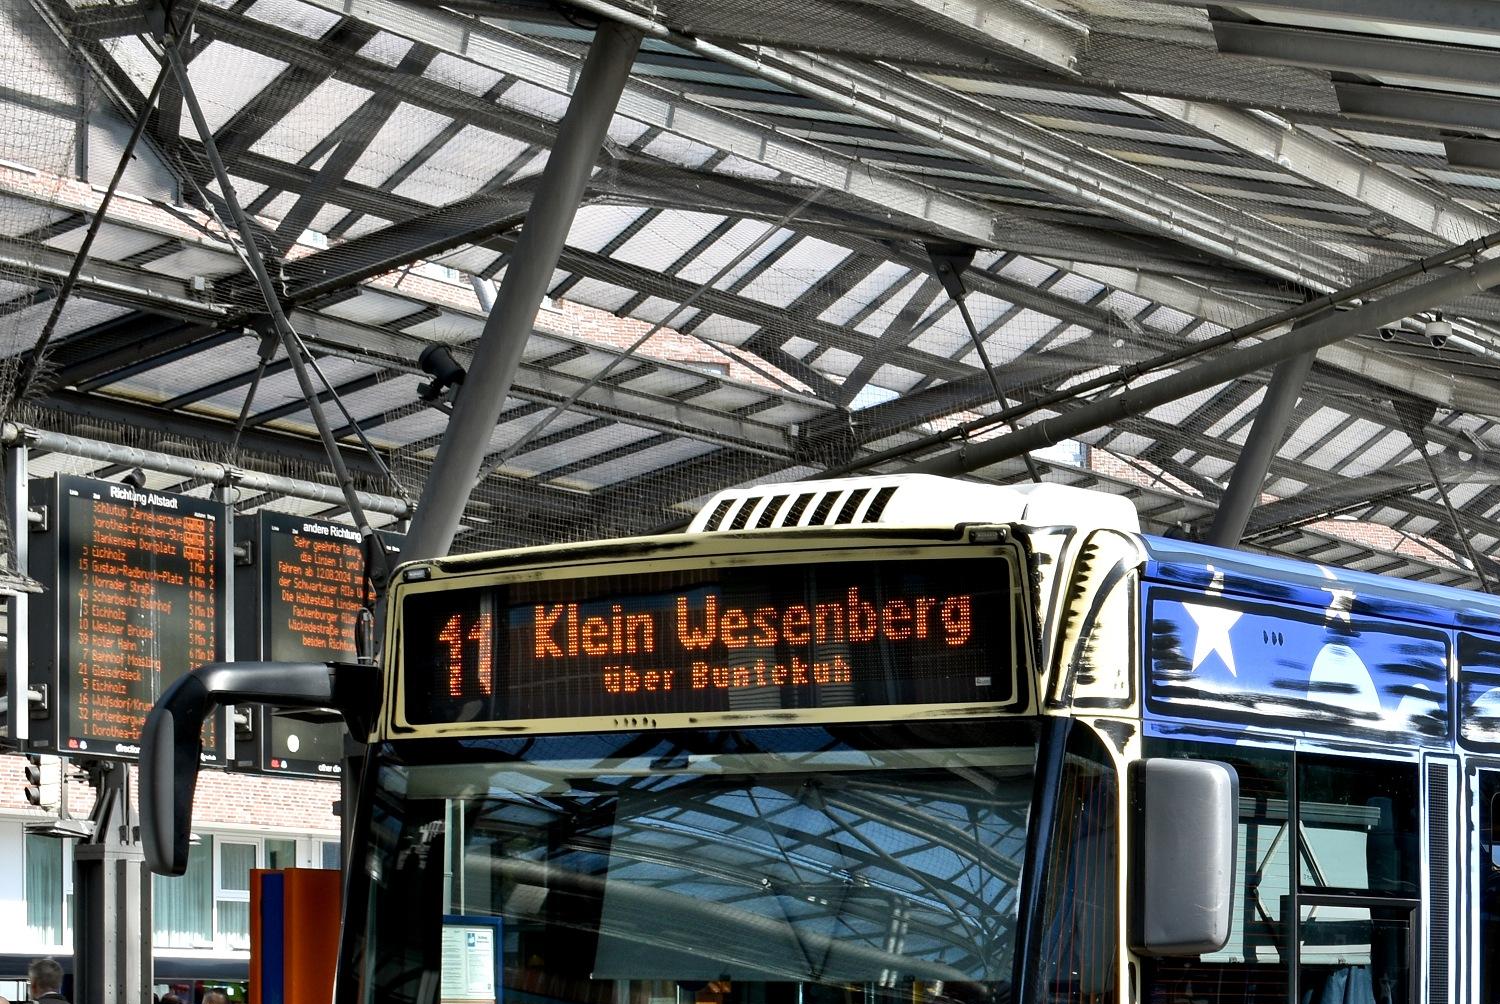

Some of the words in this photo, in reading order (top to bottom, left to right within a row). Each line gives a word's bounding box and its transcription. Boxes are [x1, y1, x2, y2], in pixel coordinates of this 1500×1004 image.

[110, 486, 146, 506] Richtung
[148, 492, 178, 509] Altstadt
[294, 536, 310, 548] Sehr
[303, 523, 329, 535] andere
[330, 526, 362, 543] Richtung
[438, 613, 492, 696] 11
[535, 604, 654, 658] Klein
[677, 587, 971, 650] Wesenberg
[604, 665, 673, 693] über
[692, 656, 852, 689] Buntekuh
